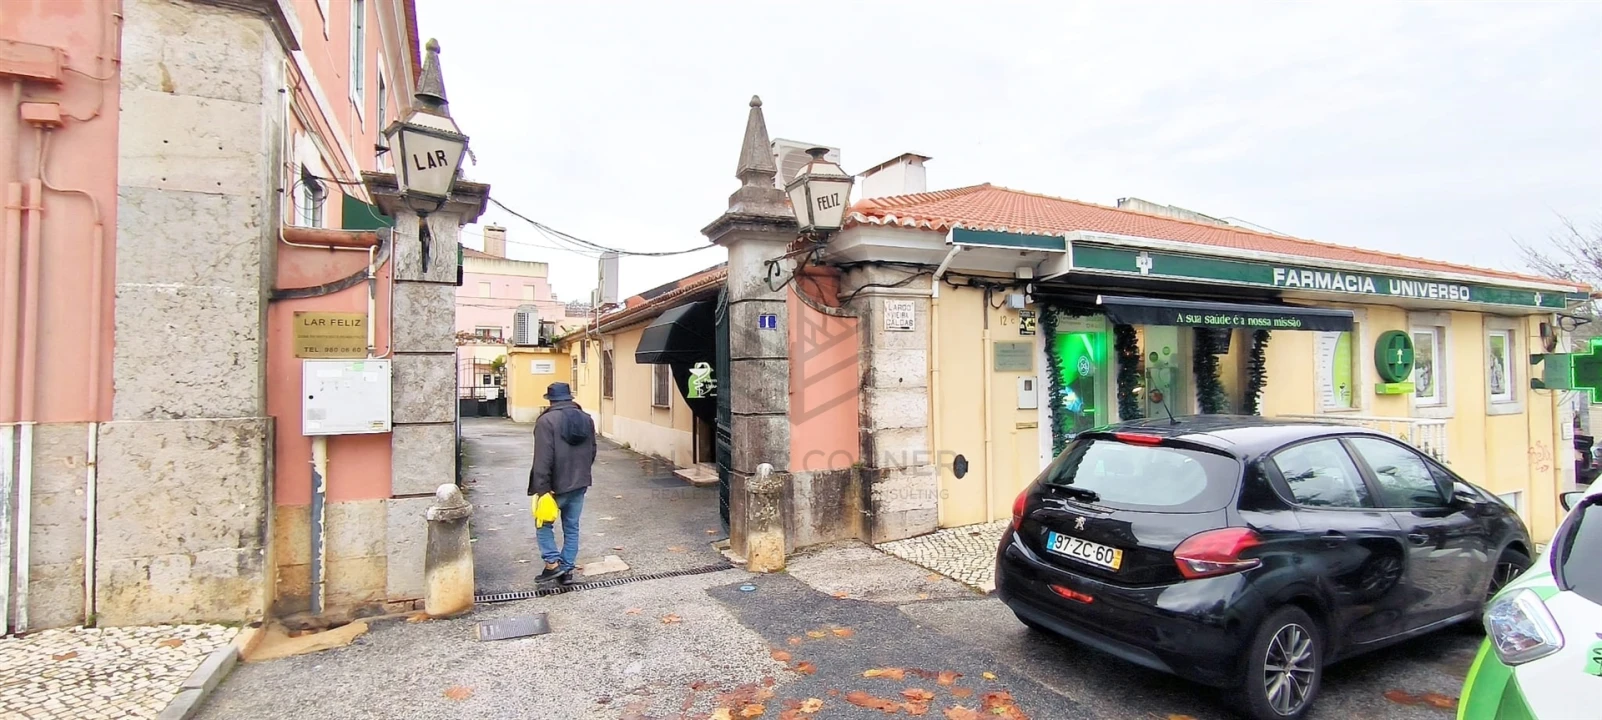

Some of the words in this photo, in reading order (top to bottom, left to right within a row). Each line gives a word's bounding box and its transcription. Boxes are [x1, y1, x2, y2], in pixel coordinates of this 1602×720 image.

[412, 149, 449, 171] LAR
[816, 192, 841, 212] FELIZ
[1389, 279, 1471, 301] UNIVERSO
[304, 318, 326, 326] LAR
[331, 318, 361, 326] FELIZ
[1000, 315, 1008, 326] 12
[1176, 312, 1184, 323] A
[1185, 314, 1202, 324] sua
[1204, 313, 1232, 325] saúde
[1240, 316, 1245, 325] a
[1247, 316, 1272, 326] nossa
[1055, 534, 1115, 564] 97-ZC-60
